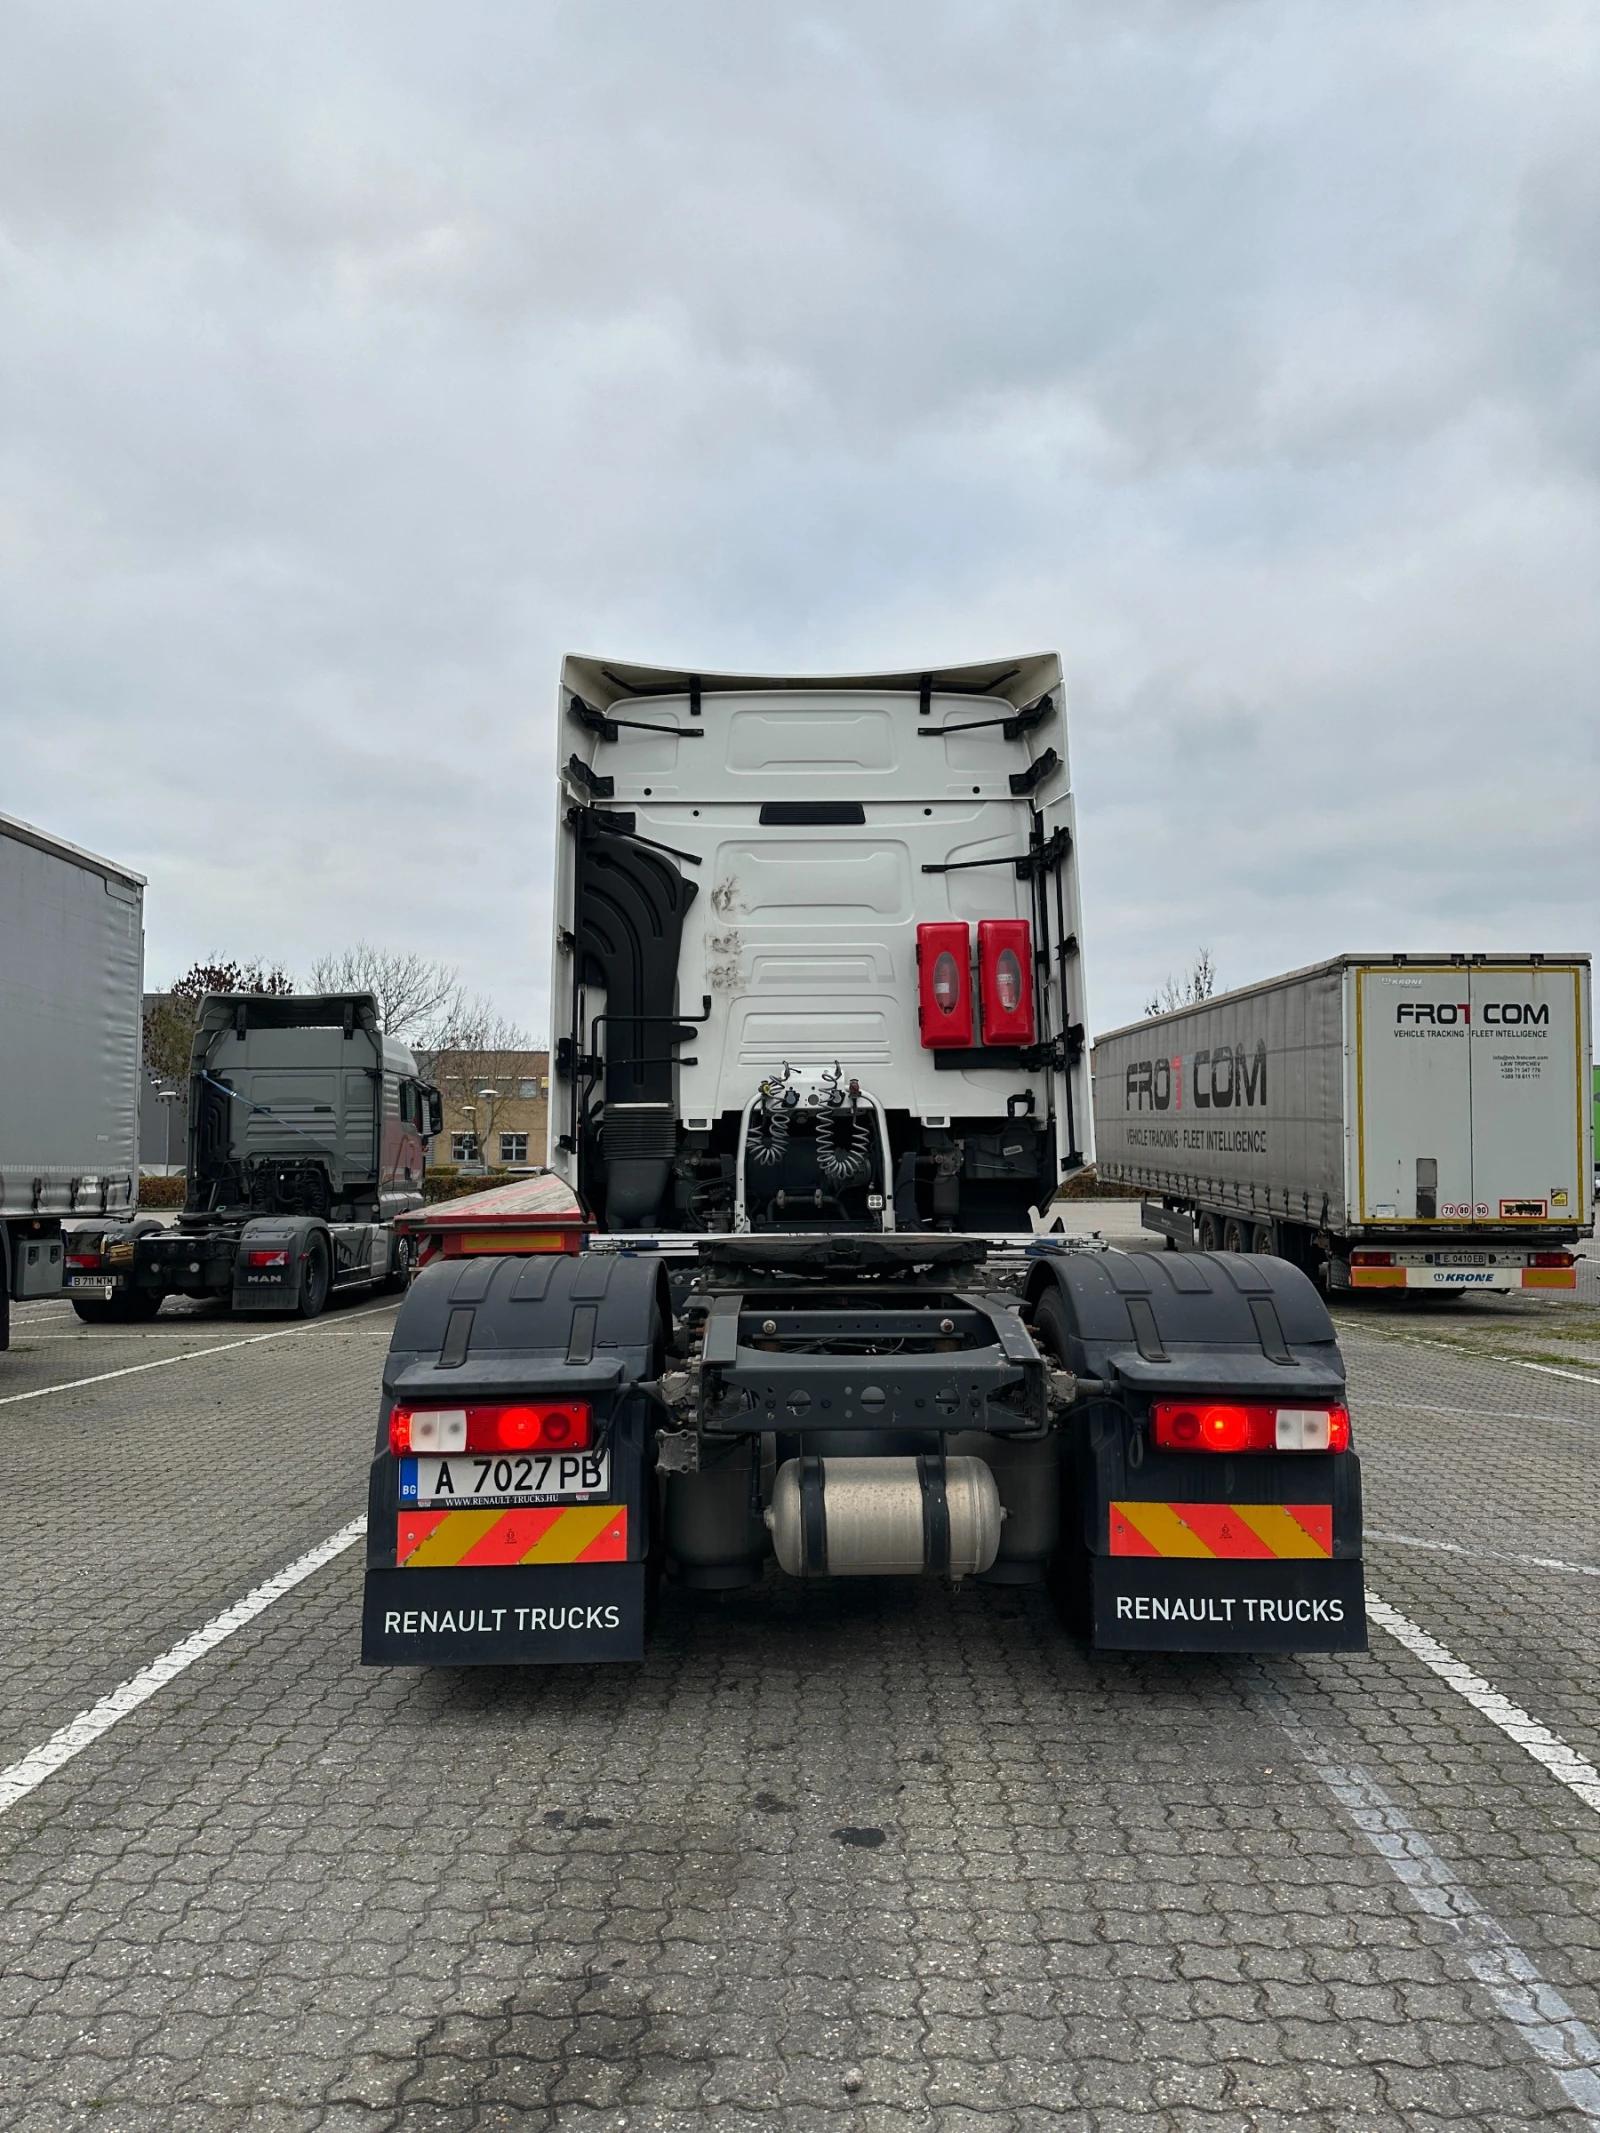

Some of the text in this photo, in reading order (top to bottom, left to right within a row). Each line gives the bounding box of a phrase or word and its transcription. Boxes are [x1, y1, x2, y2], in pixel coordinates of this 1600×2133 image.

[1394, 1030, 1425, 1038] VEHICLE
[1427, 1030, 1465, 1038] TRACKING
[1471, 1030, 1494, 1038] FLEET
[1495, 1030, 1548, 1038] INTELLIGENCE
[1126, 1129, 1148, 1146] VEHICLE
[1149, 1129, 1179, 1148] TRACKING
[1184, 1129, 1204, 1149] FLEET
[1206, 1130, 1267, 1153] INTELLIGENCE
[1444, 1206, 1454, 1214] 70
[1460, 1206, 1469, 1214] 80
[1476, 1206, 1486, 1214] 90
[1443, 1254, 1484, 1263] E 0410 EB
[74, 1277, 80, 1286] B
[83, 1277, 94, 1286] 711
[247, 1275, 282, 1283] MAN
[1445, 1273, 1495, 1282] KRONE
[435, 1456, 602, 1495] A 7027 PB
[402, 1485, 417, 1496] BG
[445, 1494, 559, 1507] WWW.RENAULT-TRUCKS.HU
[1116, 1596, 1344, 1622] RENAULT TRUCKS
[384, 1605, 620, 1634] RENAULT TRUCKS
